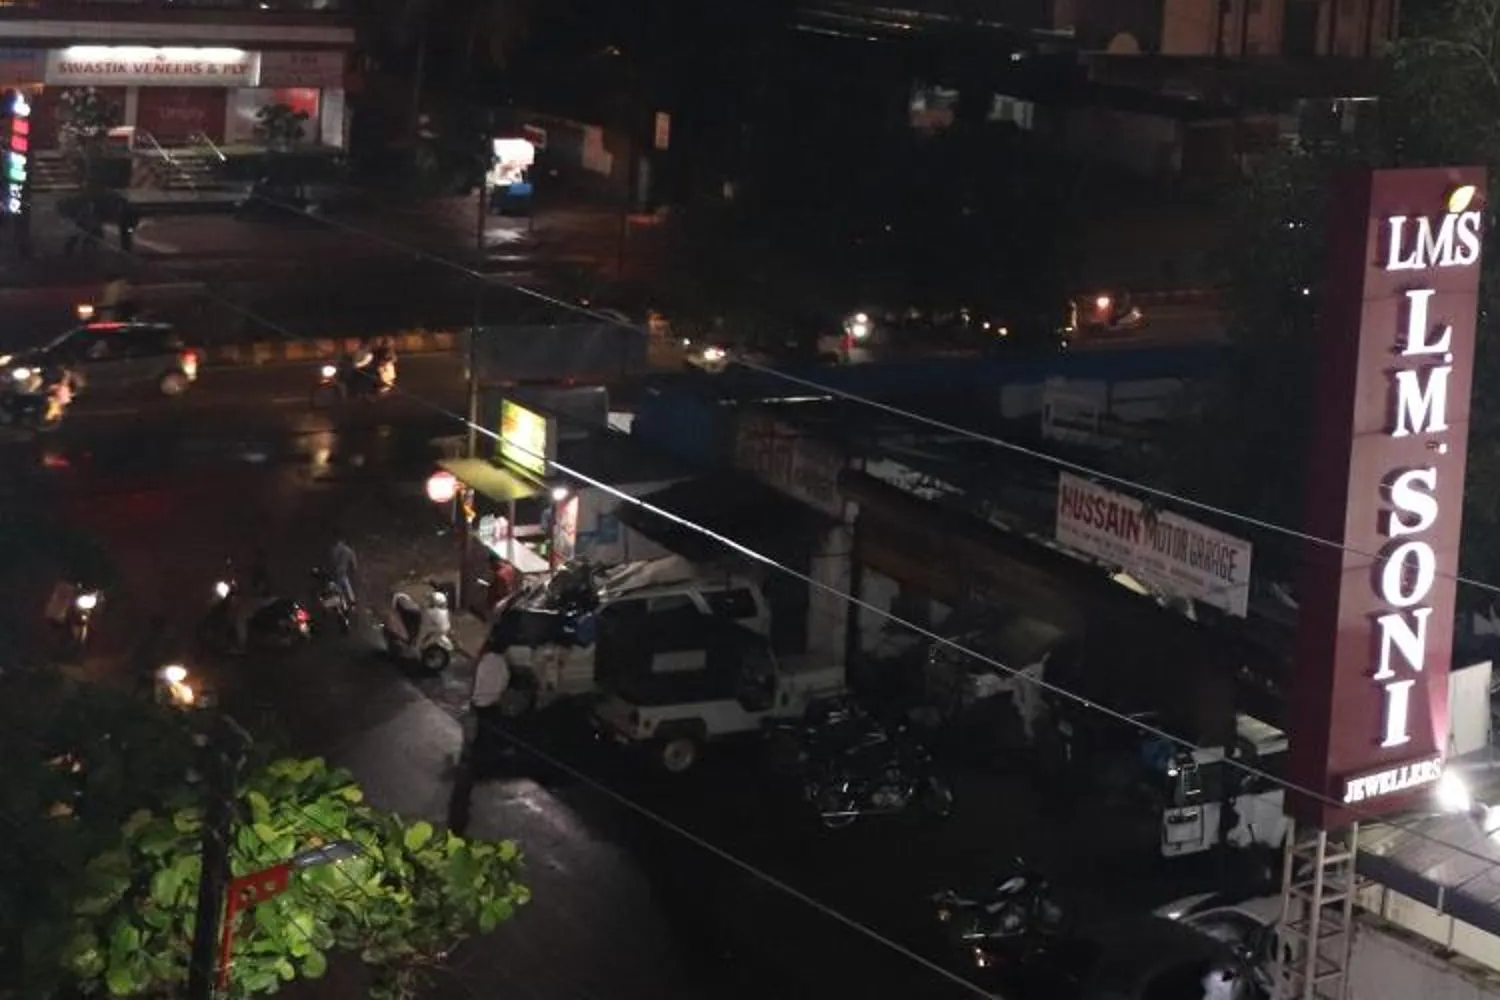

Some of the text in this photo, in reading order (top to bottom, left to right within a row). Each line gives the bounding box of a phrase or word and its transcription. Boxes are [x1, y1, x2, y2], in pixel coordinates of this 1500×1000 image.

[58, 61, 126, 75] SWASTIK
[1387, 211, 1481, 270] LMS
[1060, 484, 1141, 545] HUSSAIN
[1143, 514, 1187, 563] MOTOR
[1343, 758, 1442, 804] JEWELLERS
